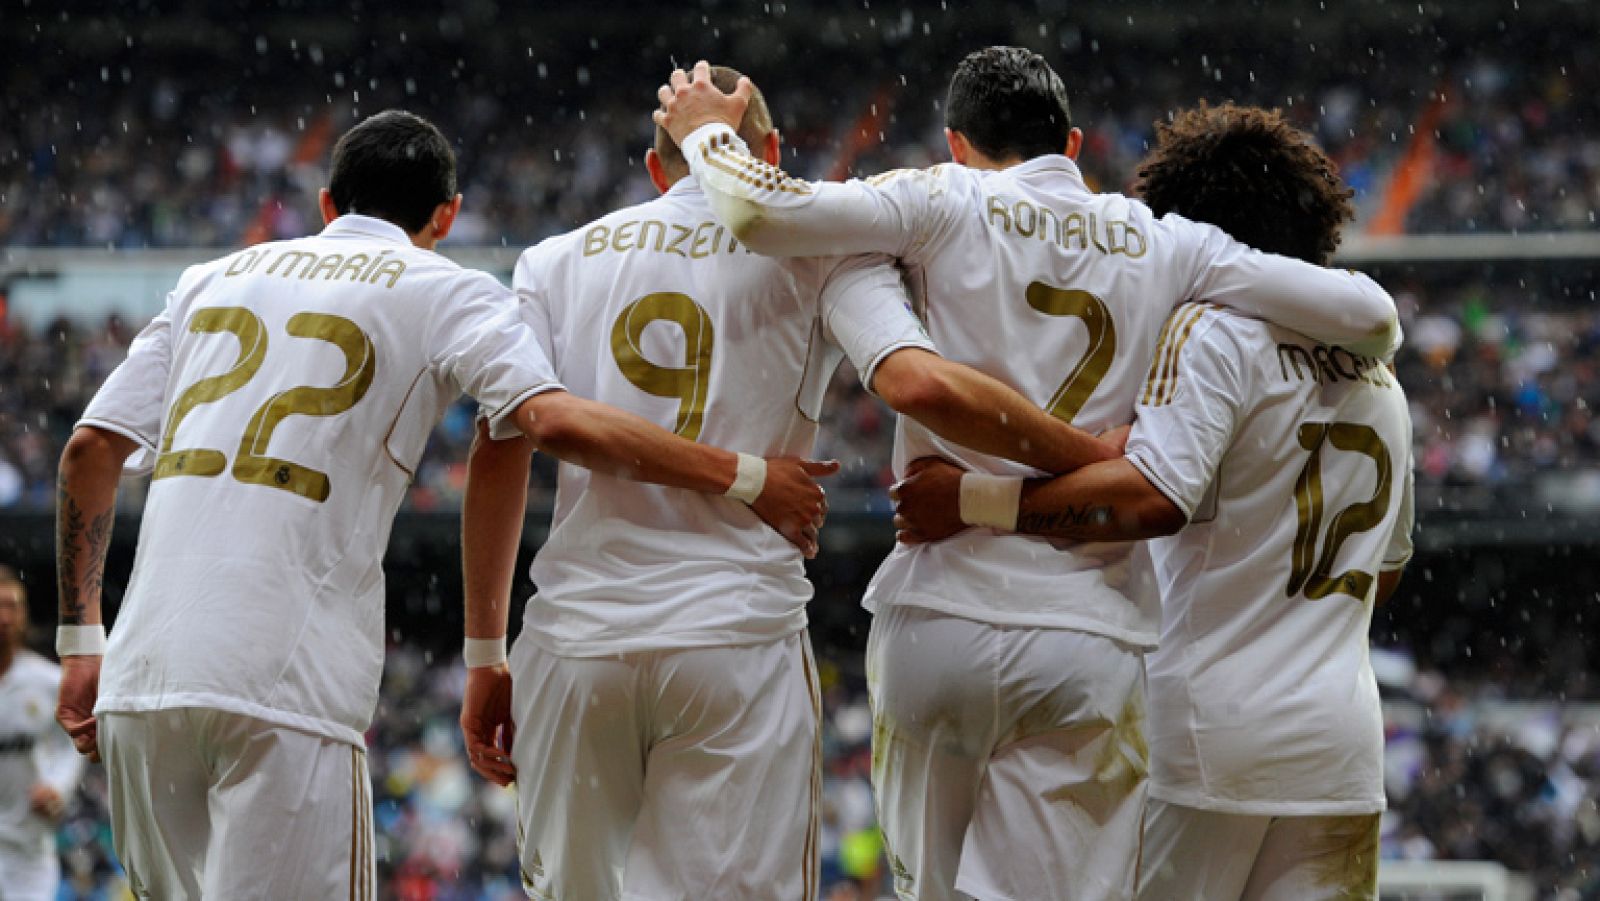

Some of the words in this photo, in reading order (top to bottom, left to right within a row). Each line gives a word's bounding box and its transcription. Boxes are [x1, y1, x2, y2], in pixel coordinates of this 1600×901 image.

[224, 249, 271, 277] DI
[265, 249, 406, 288] MARÍA
[583, 220, 751, 259] BENZE
[986, 195, 1147, 258] RONALDO
[151, 306, 376, 503] 22
[610, 291, 715, 442] 9
[1025, 281, 1117, 424] 7
[1286, 422, 1392, 601] 12
